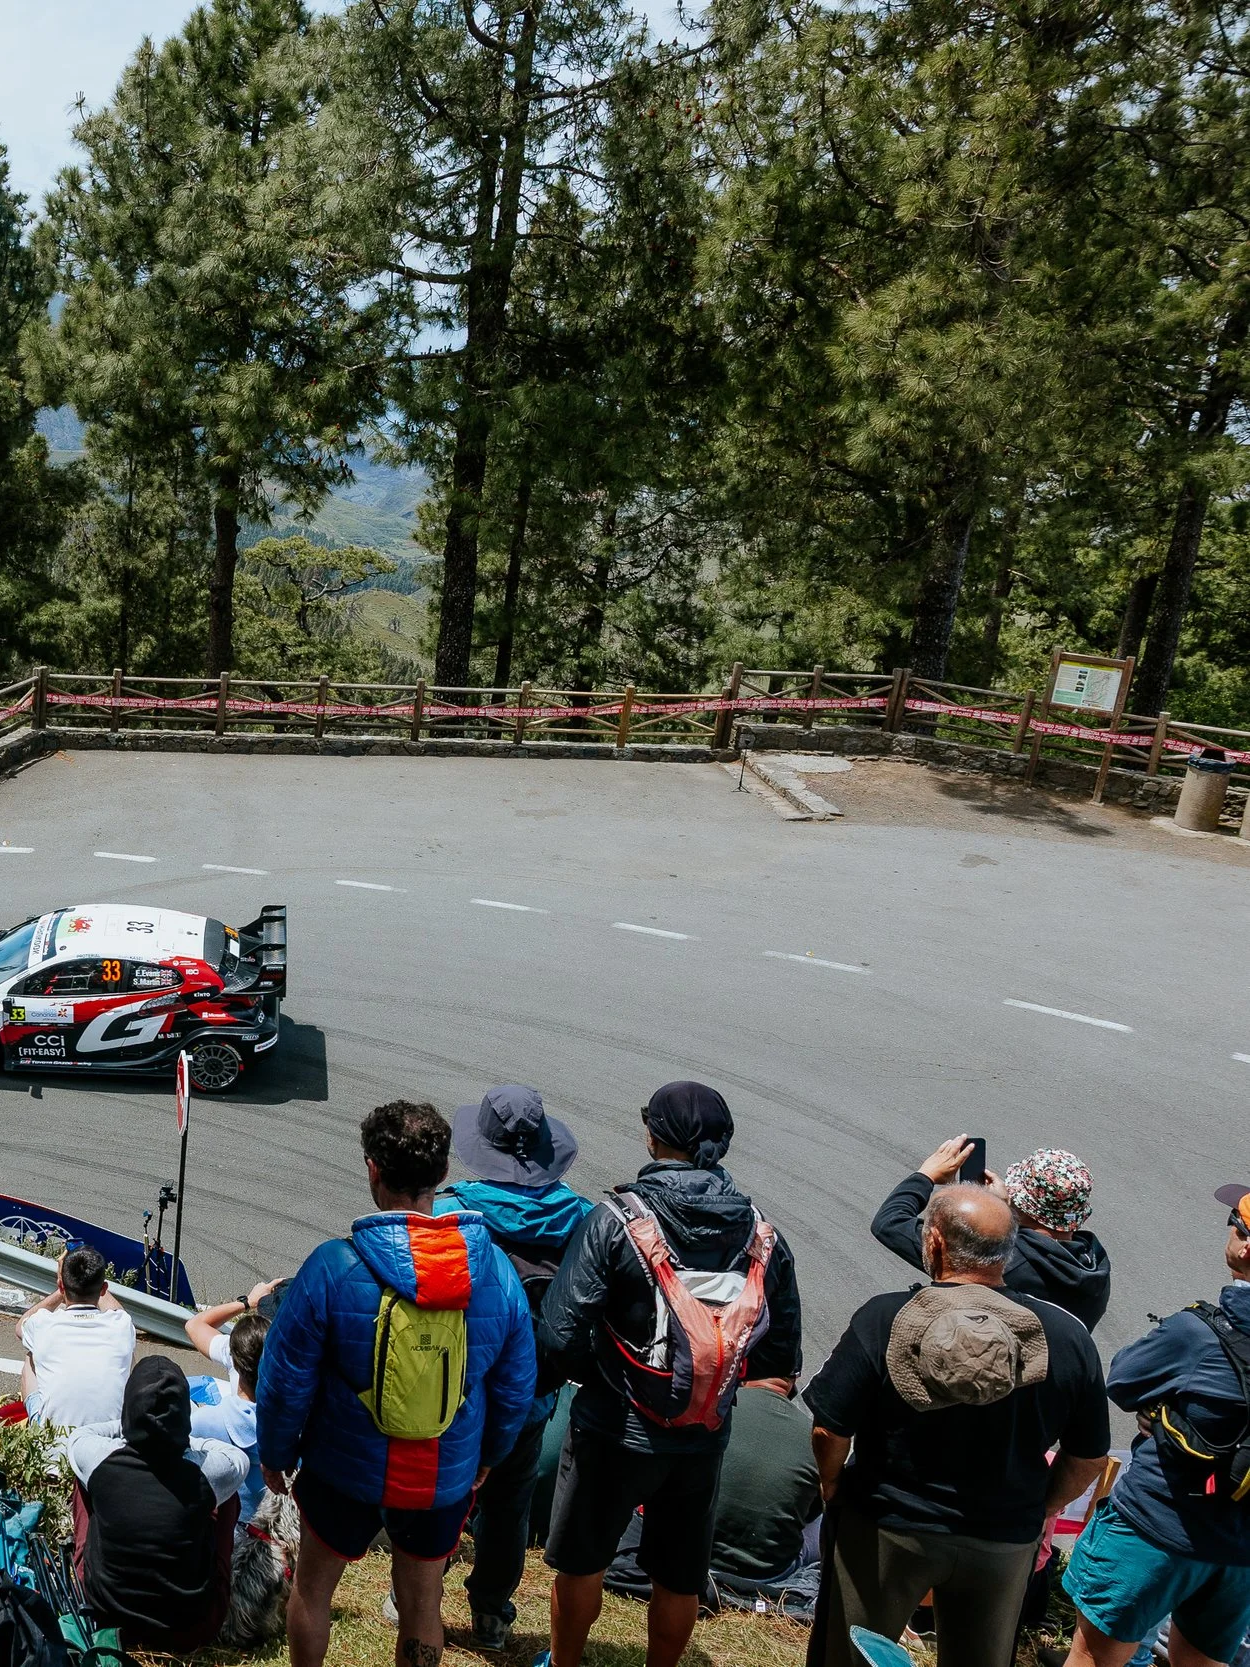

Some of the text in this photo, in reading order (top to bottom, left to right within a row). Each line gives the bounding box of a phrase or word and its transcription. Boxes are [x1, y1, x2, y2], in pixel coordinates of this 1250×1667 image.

[102, 960, 121, 982] 33
[135, 969, 160, 977] E.Evans
[132, 978, 161, 986] S.Martin
[10, 1008, 25, 1020] 33
